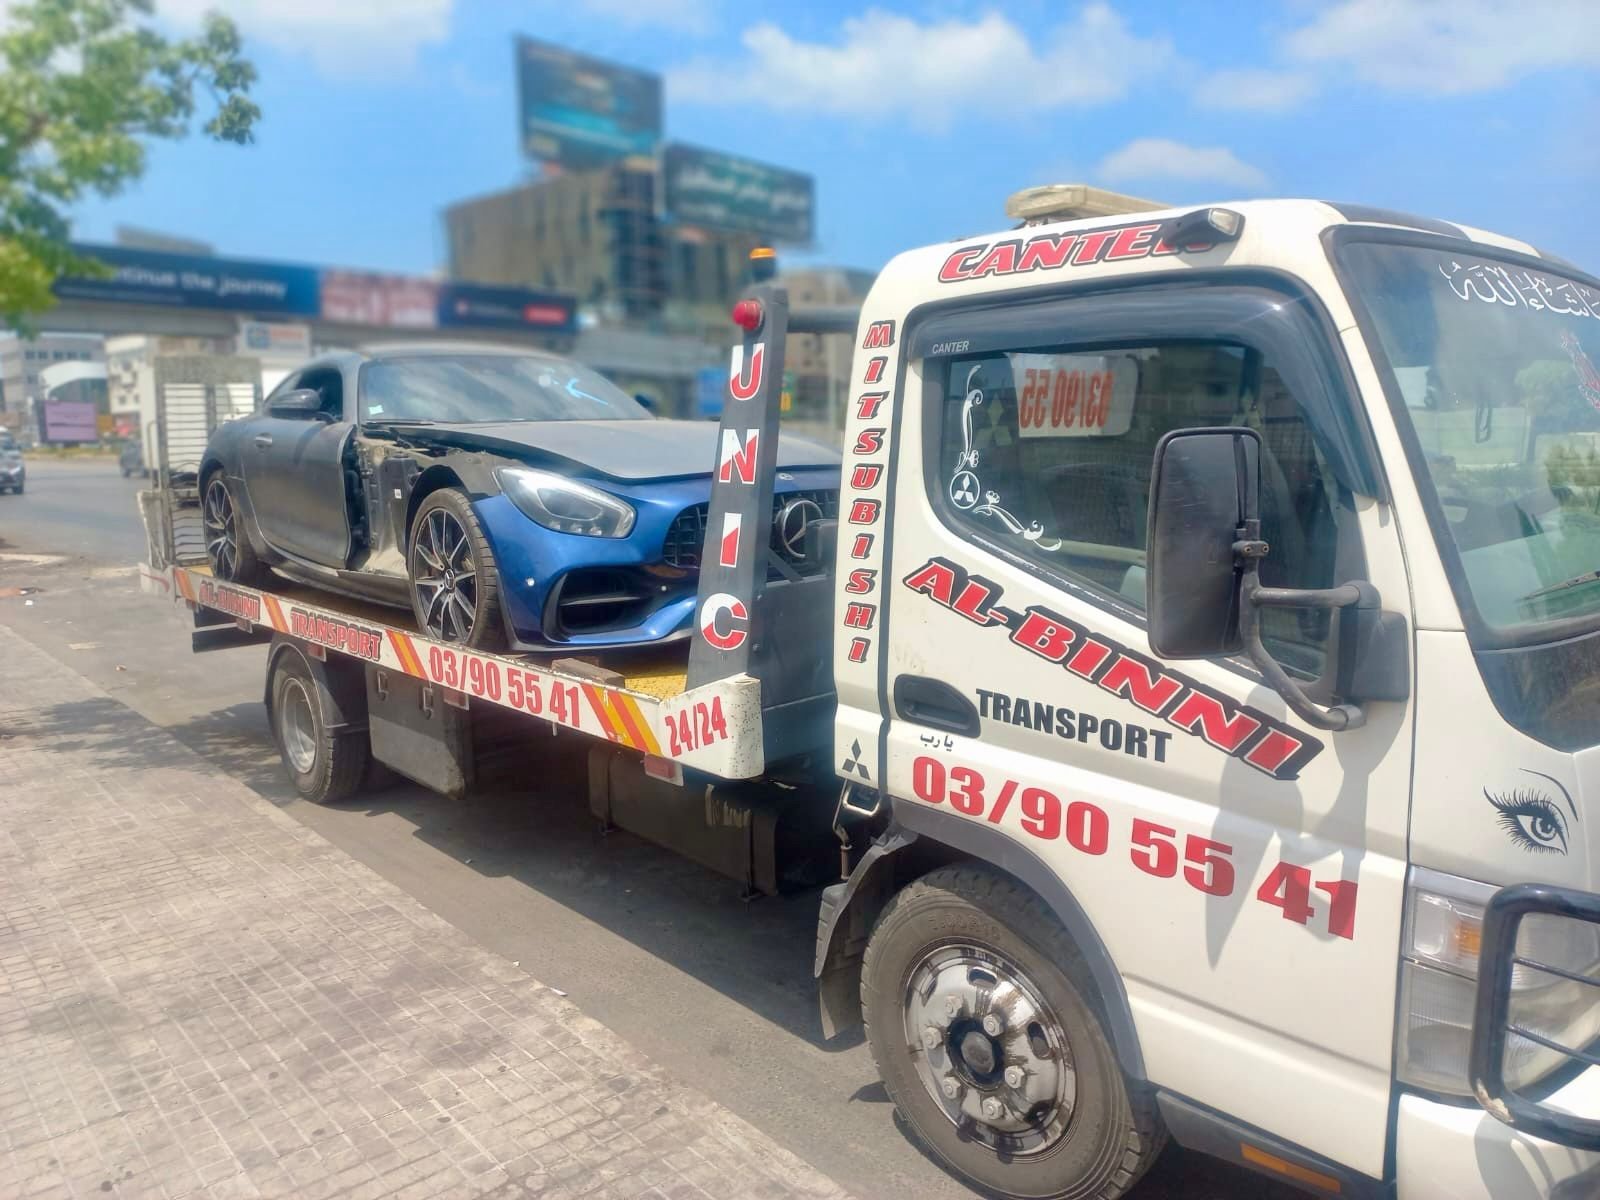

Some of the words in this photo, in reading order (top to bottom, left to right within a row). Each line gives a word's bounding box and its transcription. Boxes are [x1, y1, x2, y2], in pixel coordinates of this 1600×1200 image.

[938, 221, 1218, 283] CANTE
[932, 340, 970, 354] CANTER
[700, 342, 765, 651] UNIC
[837, 319, 897, 664] MITSUBISHI
[290, 607, 382, 662] TRANSPORT
[902, 556, 1326, 781] AL-BINNI
[429, 646, 501, 701] 03/90
[507, 667, 543, 715] 55
[549, 680, 581, 728] 41
[665, 695, 728, 757] 24/24
[976, 688, 1172, 763] TRANSPORT
[912, 756, 1109, 856] 03/90
[1130, 817, 1235, 897] 55
[1256, 861, 1358, 940] 41
